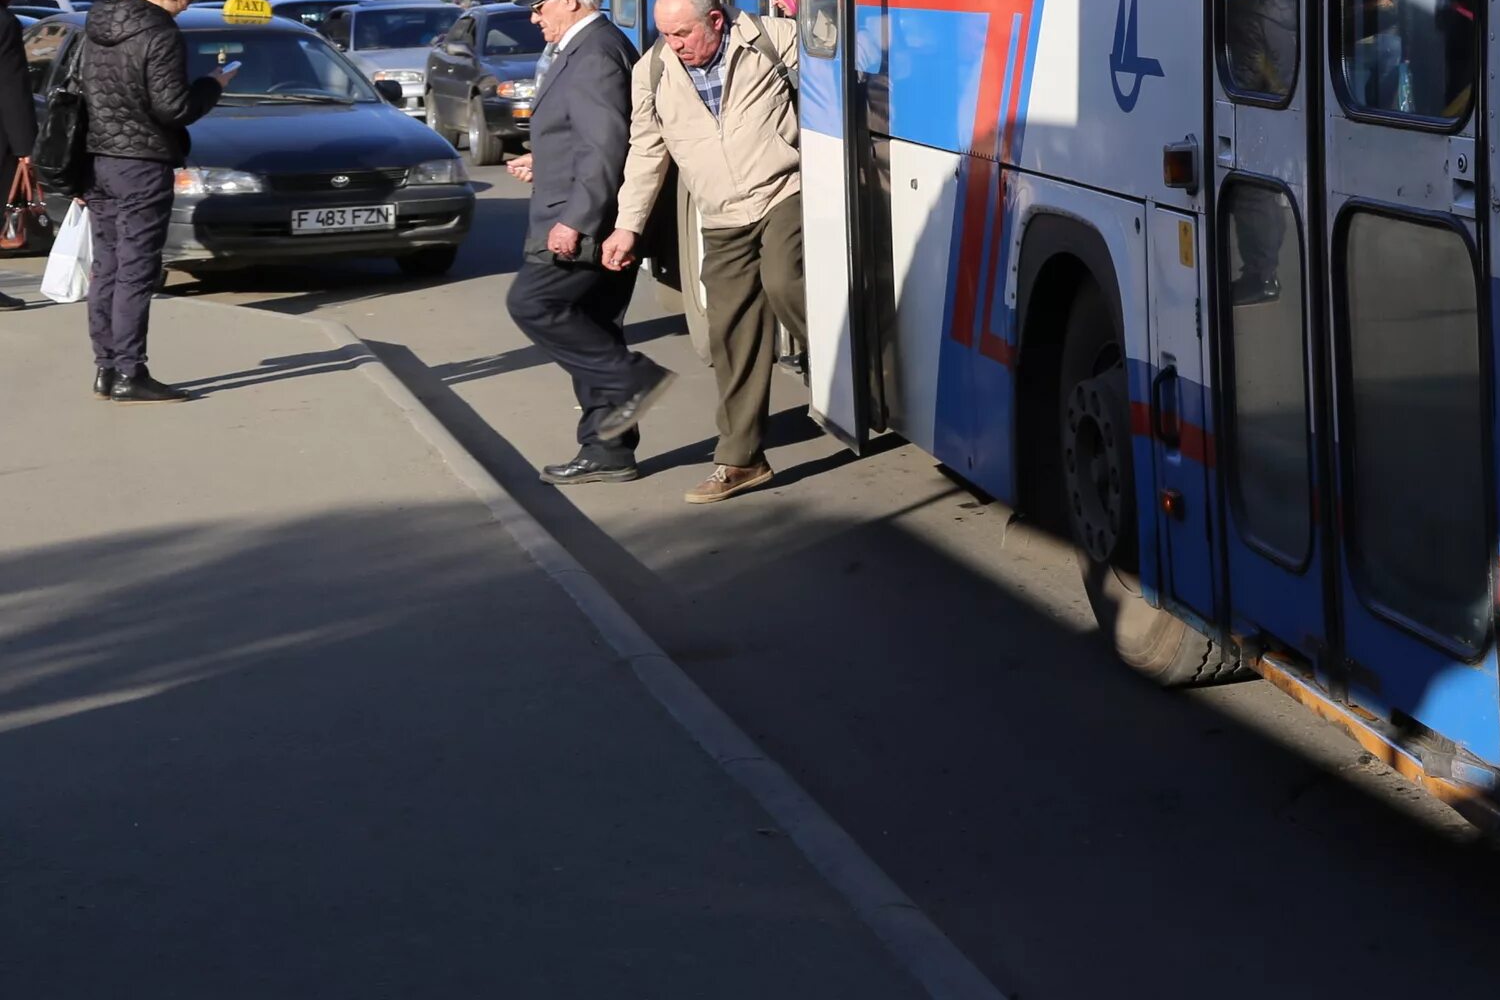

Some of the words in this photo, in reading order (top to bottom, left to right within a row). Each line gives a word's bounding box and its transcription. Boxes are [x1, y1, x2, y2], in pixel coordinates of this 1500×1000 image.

[234, 0, 264, 12] TAXI
[297, 211, 309, 228] F
[315, 210, 346, 227] 483
[351, 207, 389, 225] FZN
